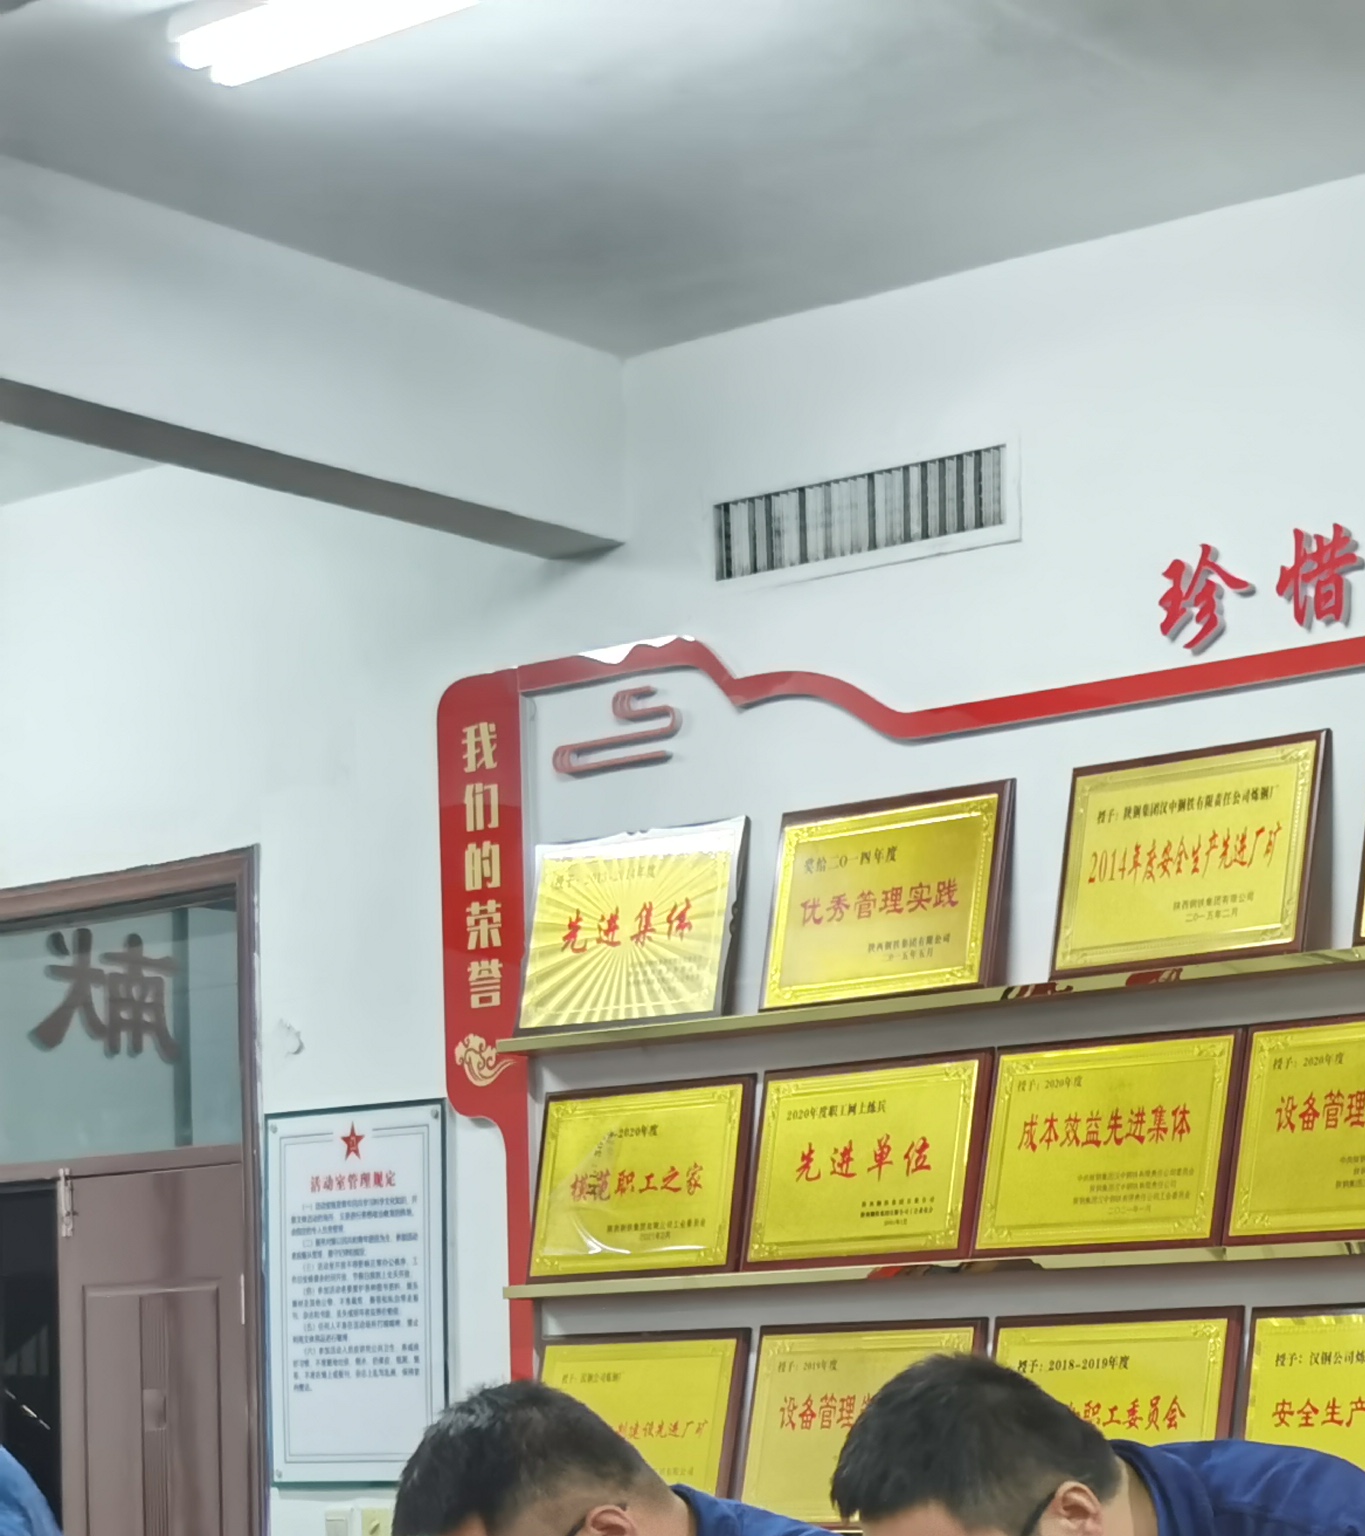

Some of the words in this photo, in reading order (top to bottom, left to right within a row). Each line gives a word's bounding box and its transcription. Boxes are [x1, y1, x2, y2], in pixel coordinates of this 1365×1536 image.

[461, 721, 503, 1009] 我们的荣誉
[1088, 820, 1283, 885] 2014年度安全生产先进厂矿
[561, 897, 692, 954] 先进集体
[801, 878, 959, 927] 优秀管理实践
[1017, 1102, 1192, 1153] 成本效益先进集体
[310, 1170, 397, 1193] 活动室管理规定
[796, 1133, 932, 1183] 先进单位
[1067, 1395, 1186, 1432] 职工委员会
